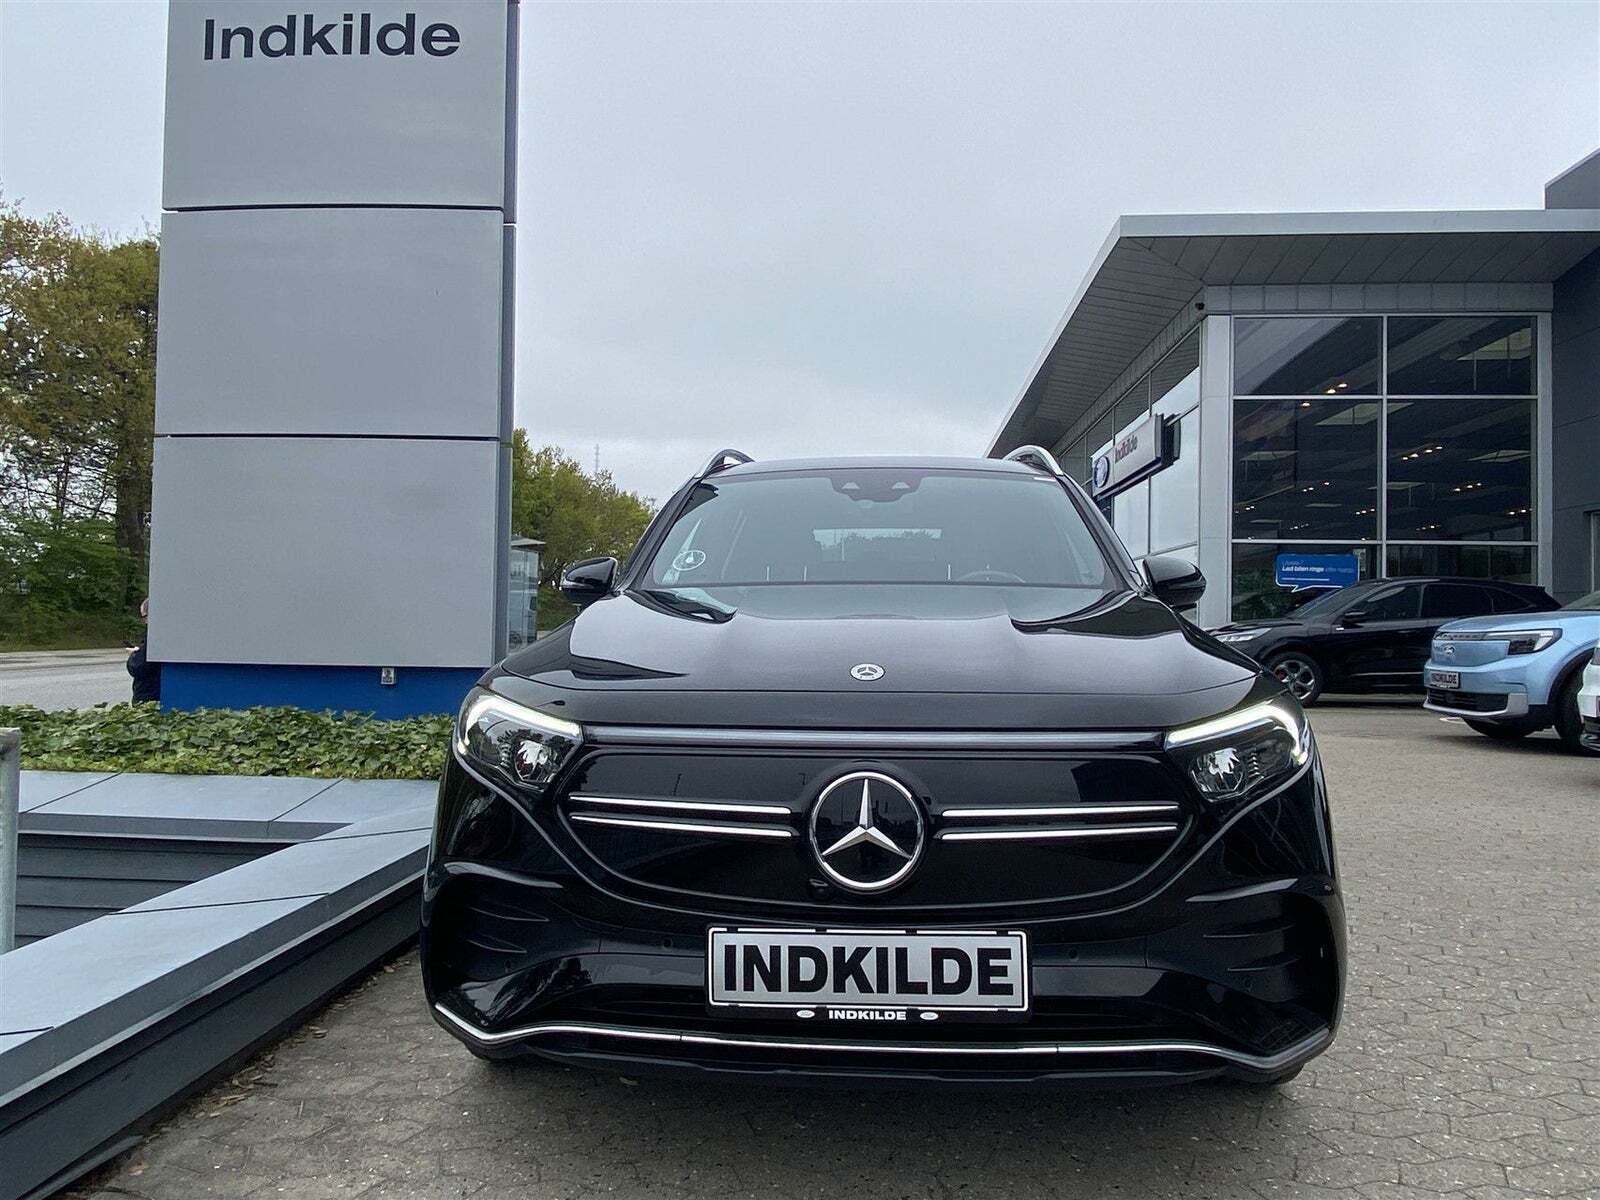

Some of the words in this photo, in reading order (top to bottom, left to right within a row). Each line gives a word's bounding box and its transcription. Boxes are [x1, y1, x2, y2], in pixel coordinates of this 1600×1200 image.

[203, 13, 460, 60] Indkilde
[724, 944, 1014, 995] INDKILDE
[828, 1009, 907, 1021] INDKILDE
